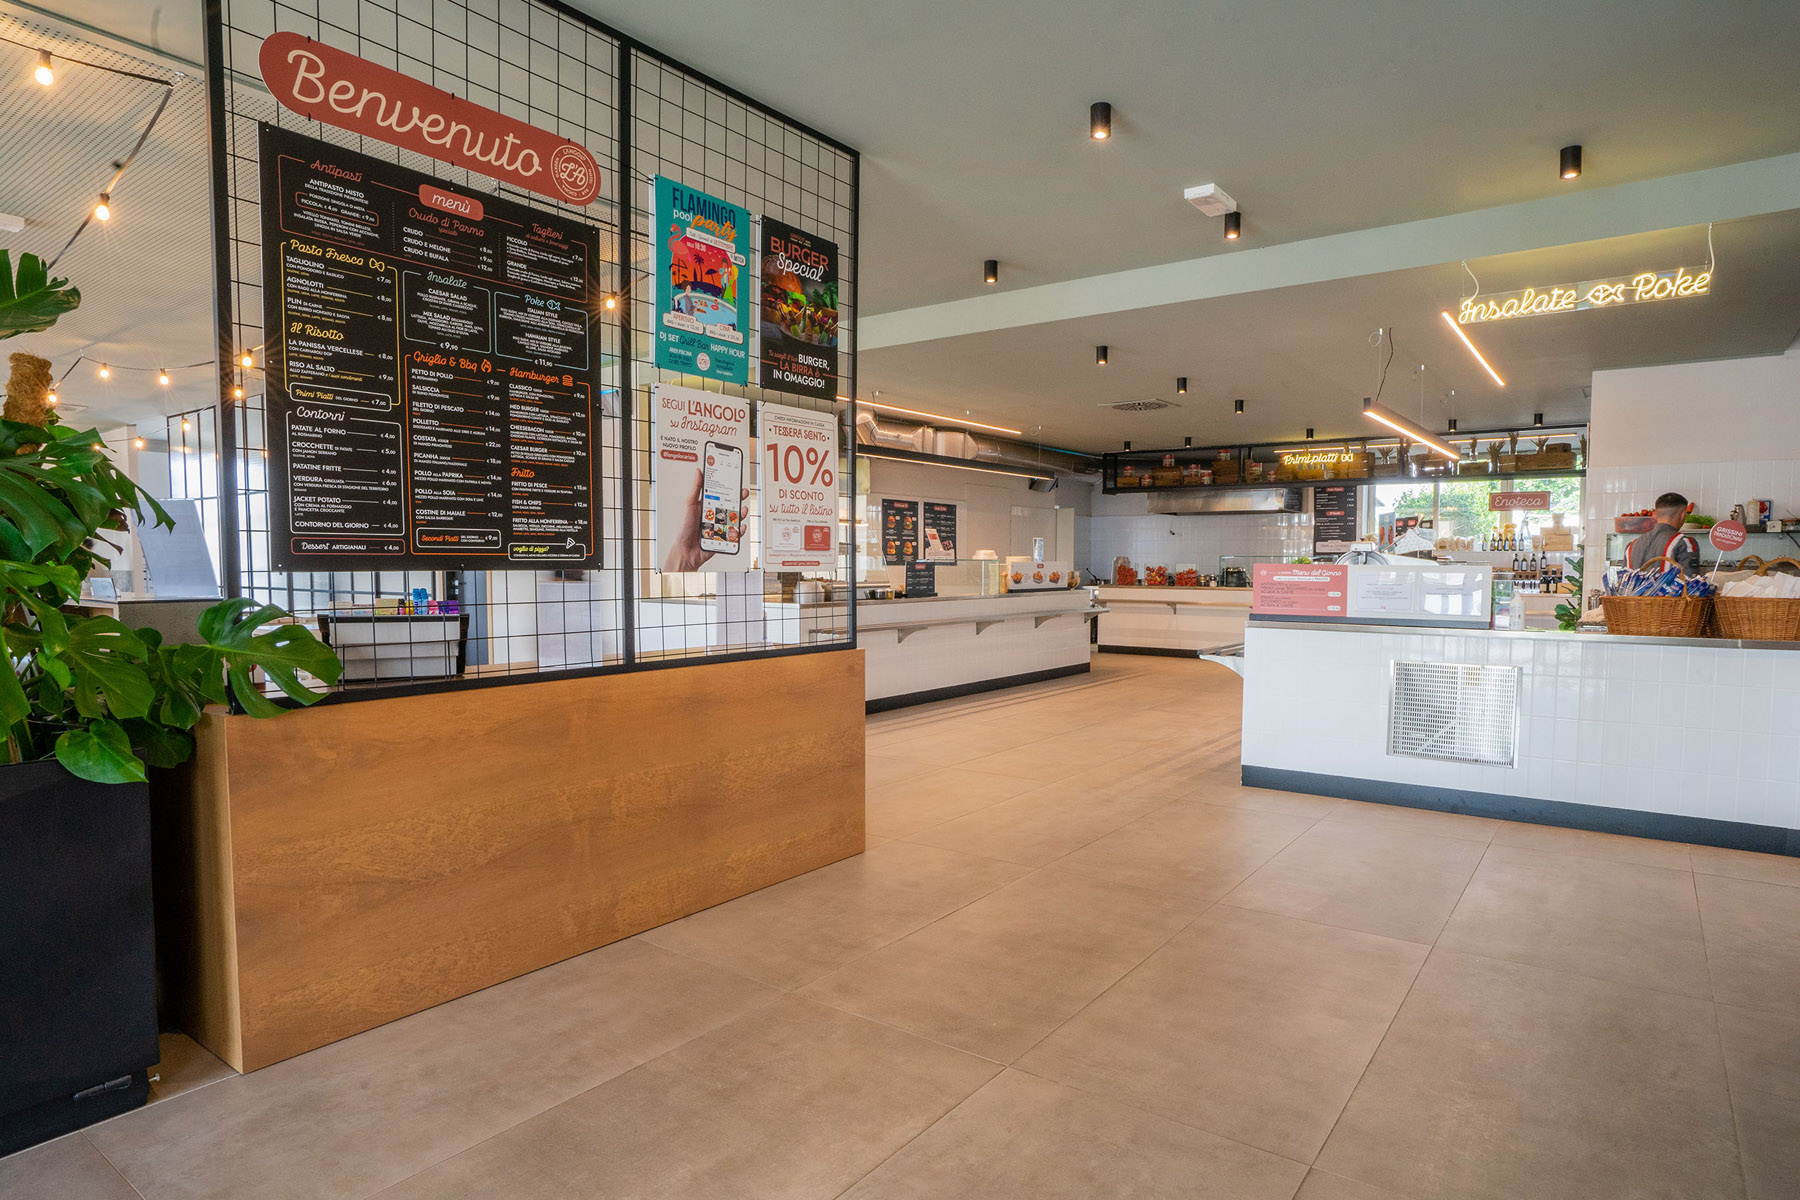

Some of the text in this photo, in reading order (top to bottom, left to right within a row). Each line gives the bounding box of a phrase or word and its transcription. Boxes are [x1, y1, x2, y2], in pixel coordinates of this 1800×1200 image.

[288, 50, 542, 176] Benvenuto
[310, 160, 363, 182] Antipasti
[309, 179, 365, 199] ANTIPASTO MISTO
[432, 194, 471, 213] menù
[672, 187, 736, 229] FLAMINGO
[408, 207, 439, 224] Crudo
[441, 217, 450, 227] di
[453, 219, 485, 237] Parma
[673, 209, 693, 222] pool
[690, 214, 737, 243] party
[403, 226, 424, 237] CRUDO
[532, 223, 564, 240] Taglieri
[403, 236, 424, 247] CRUDO
[429, 243, 452, 254] MELONE
[506, 236, 528, 246] PICCOLO
[290, 239, 364, 266] Pasta Fresca
[403, 246, 424, 256] CRUDO
[429, 252, 450, 262] BUFALA
[770, 236, 830, 272] BURGER
[286, 255, 325, 269] TAGLIOLINO
[506, 260, 527, 269] GRANDE
[776, 252, 824, 282] Special
[286, 276, 324, 289] AGNOLOTTI
[427, 271, 467, 289] Insalate
[287, 297, 302, 305] PLIN
[428, 288, 467, 301] CAESAR SALAD
[524, 294, 545, 307] Poke
[1458, 267, 1712, 325] Insalate Poke
[433, 312, 451, 321] SALAD
[304, 324, 345, 341] Risotto
[298, 340, 326, 351] PANISSA
[326, 345, 364, 356] VERCELLESE
[668, 333, 679, 343] SET
[680, 335, 696, 348] Grill
[697, 339, 710, 351] Bar
[710, 343, 729, 355] HAPPY
[729, 348, 746, 359] HOUR
[289, 360, 305, 368] RISO
[315, 364, 335, 373] SALTO
[413, 350, 478, 373] Griglia & Bbq
[779, 359, 790, 371] LA
[791, 362, 814, 377] BIRRA
[798, 353, 830, 371] BURGER,
[411, 368, 429, 376] PETTO
[436, 372, 454, 380] POLLO
[509, 367, 560, 385] Hamburger
[773, 369, 825, 389] IN OMAGGIO!
[295, 389, 316, 398] Primi
[411, 384, 440, 393] SALSICCIA
[508, 383, 533, 392] CLASSICO
[412, 401, 433, 409] FILETTO
[521, 405, 540, 413] BURGER
[662, 397, 686, 411] SEGUI
[296, 406, 346, 421] Contorni
[291, 424, 313, 432] PATATE
[412, 418, 440, 426] POLLETTO
[509, 424, 545, 434] CHEESEBACON
[670, 415, 738, 438] su Instagram
[773, 425, 803, 439] TESSERA
[292, 441, 334, 451] CROCCHETTE
[766, 442, 834, 488] 10%
[1283, 453, 1339, 465] Primi piatti
[292, 463, 321, 471] PATATINE
[510, 467, 535, 478] Fritto
[293, 475, 323, 483] VERDURA
[441, 471, 464, 479] PAPRIKA
[778, 488, 825, 502] DI SCONTO
[1494, 495, 1543, 507] Enoteca
[769, 503, 833, 516] su tutto il listino
[1716, 526, 1744, 537] GRISSINI
